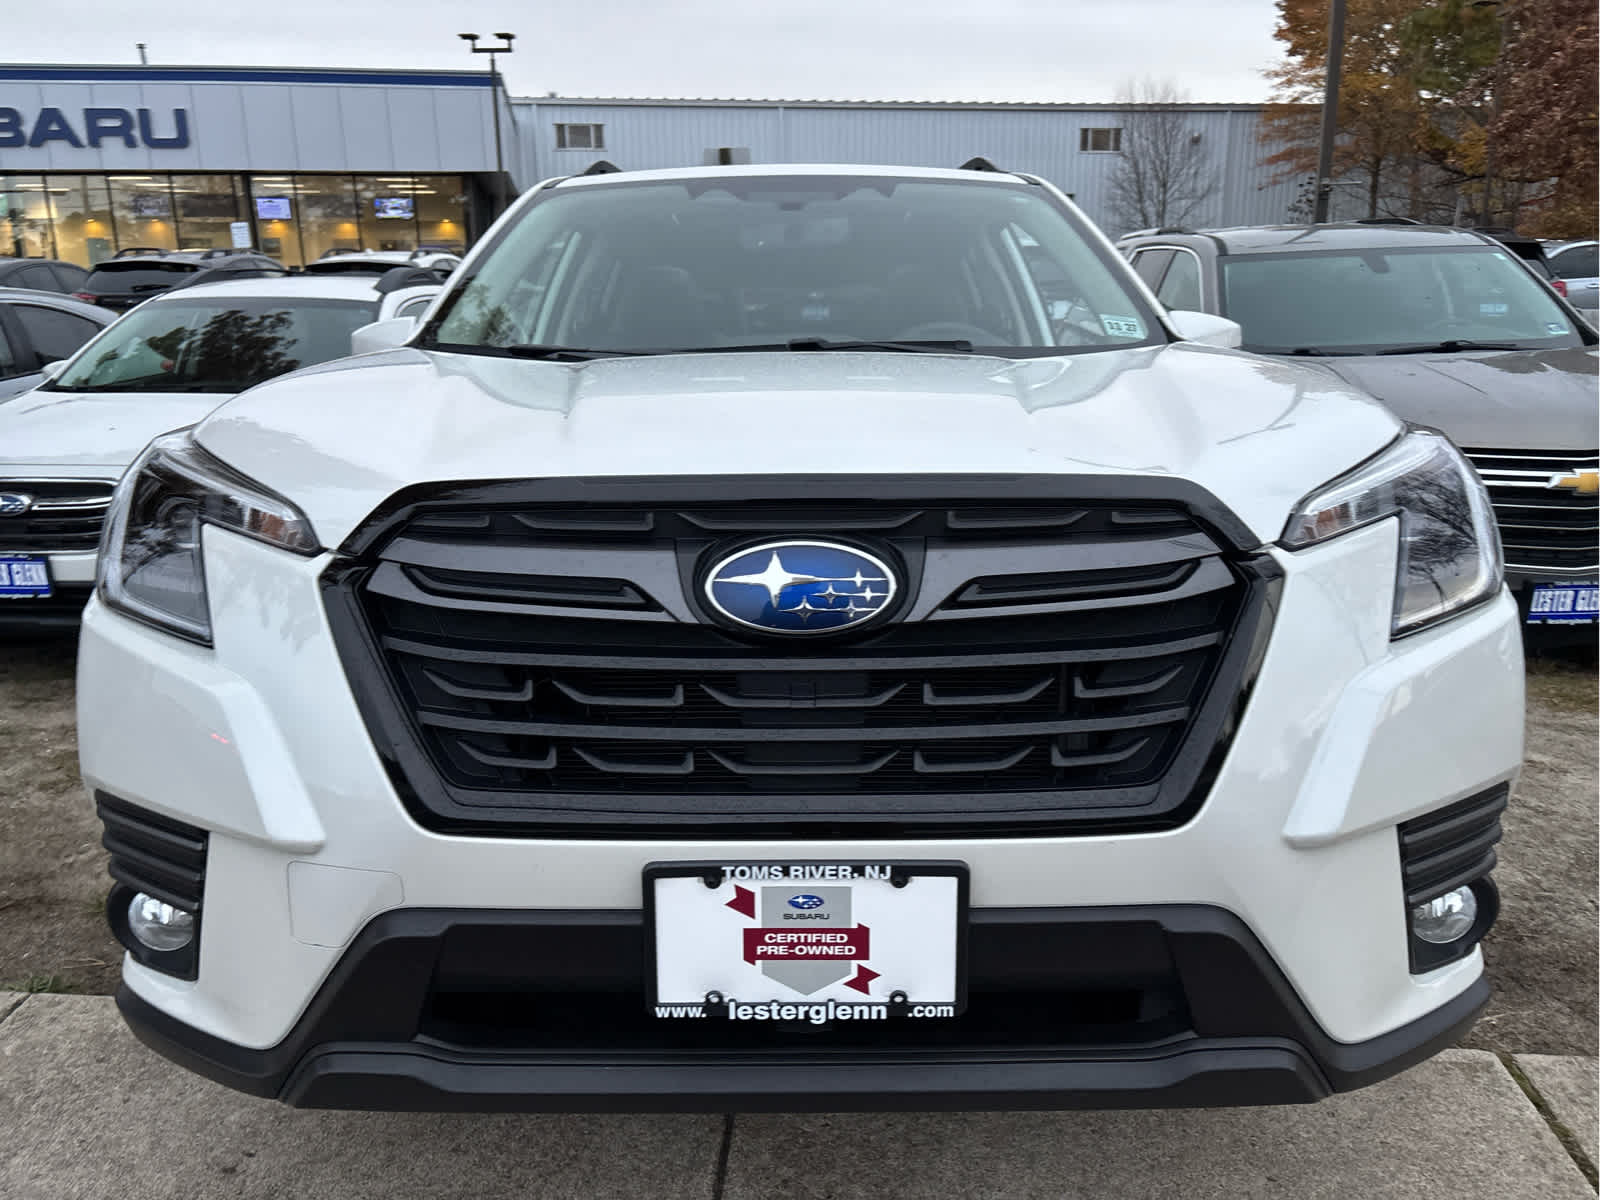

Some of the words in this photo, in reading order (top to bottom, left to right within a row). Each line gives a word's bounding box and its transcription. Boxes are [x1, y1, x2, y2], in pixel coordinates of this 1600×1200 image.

[721, 865, 783, 880] TOMS
[864, 865, 892, 880] NJ
[764, 933, 848, 943] CERTIFIED
[756, 945, 856, 955] PRE-OWNED
[655, 1006, 707, 1018] www.
[728, 1000, 887, 1024] lesterglenn
[907, 1005, 954, 1018] .com
